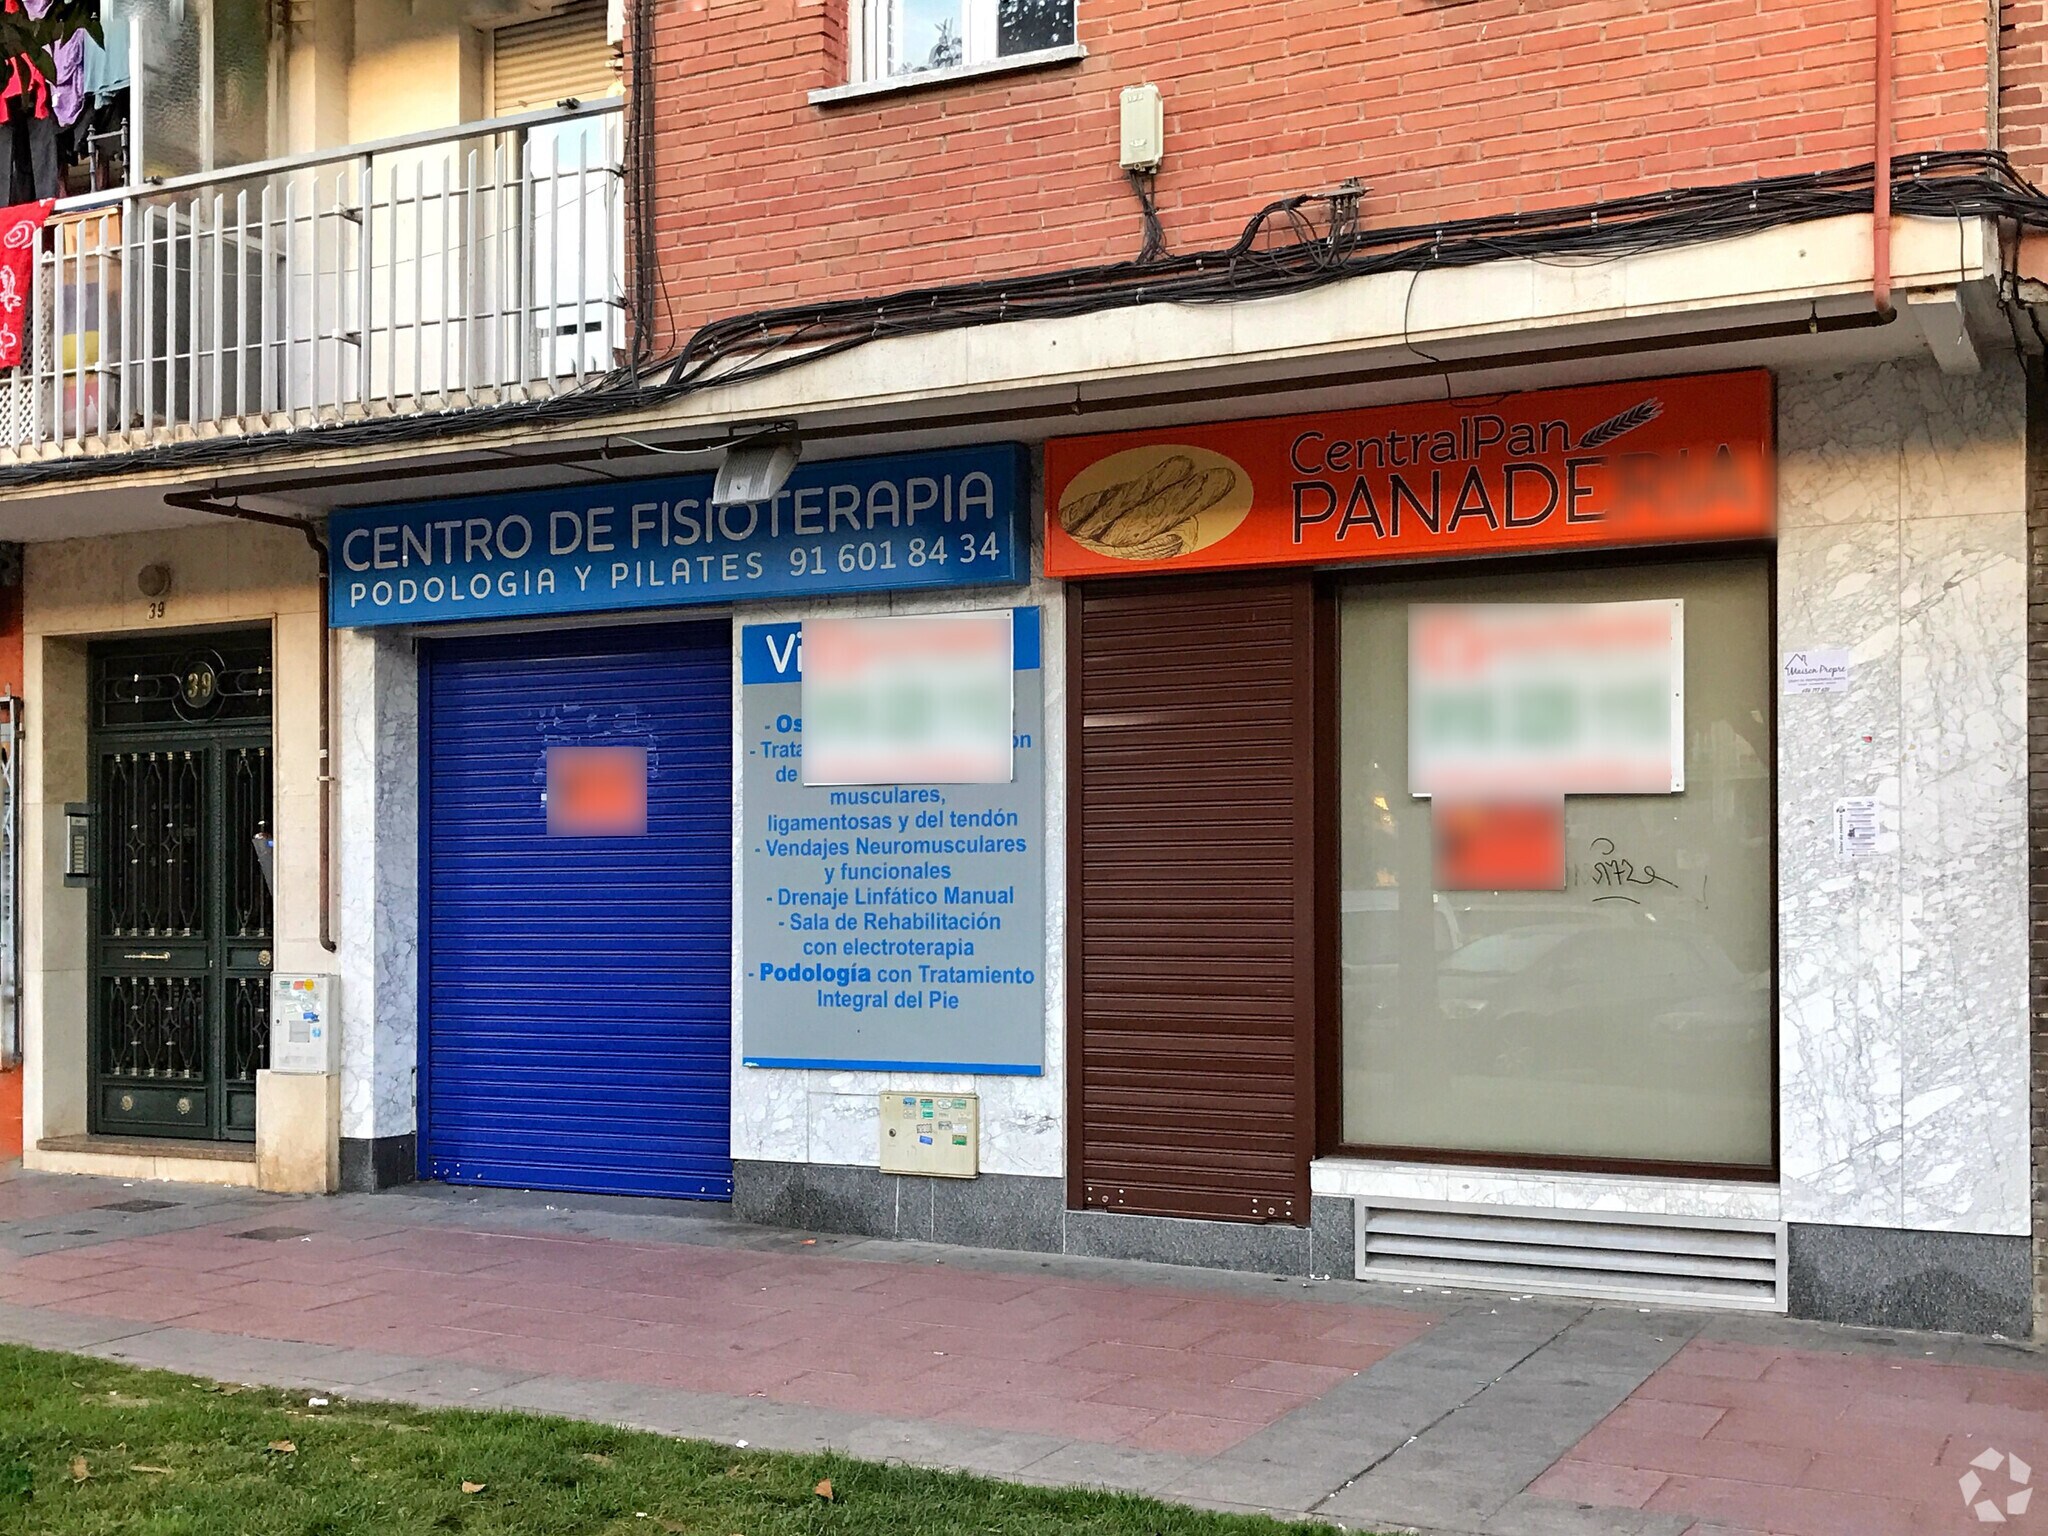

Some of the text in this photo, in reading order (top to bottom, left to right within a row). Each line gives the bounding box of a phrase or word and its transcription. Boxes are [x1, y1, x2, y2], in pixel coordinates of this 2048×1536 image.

[1290, 414, 1572, 475] CentralPan
[343, 471, 994, 571] CENTRO DE FISIOTERAPIA
[351, 531, 1000, 608] PODOLOGIA Y PILATES 91 601 84 34
[148, 601, 165, 619] 39
[187, 672, 212, 698] 39
[775, 766, 798, 783] de
[830, 787, 946, 806] musculares,
[767, 809, 1018, 836] ligamentosas y del tendón
[765, 837, 1027, 860] Vendajes Neuromusculares
[824, 862, 952, 885] y funcionales
[778, 886, 1014, 909] Drenaje Linfático Manual
[790, 911, 1001, 930] Sala de Rehabilitación
[803, 938, 975, 960] con electroterapia
[759, 963, 1036, 987] Podología con Tratamiento
[817, 989, 960, 1012] Integral del Pie
